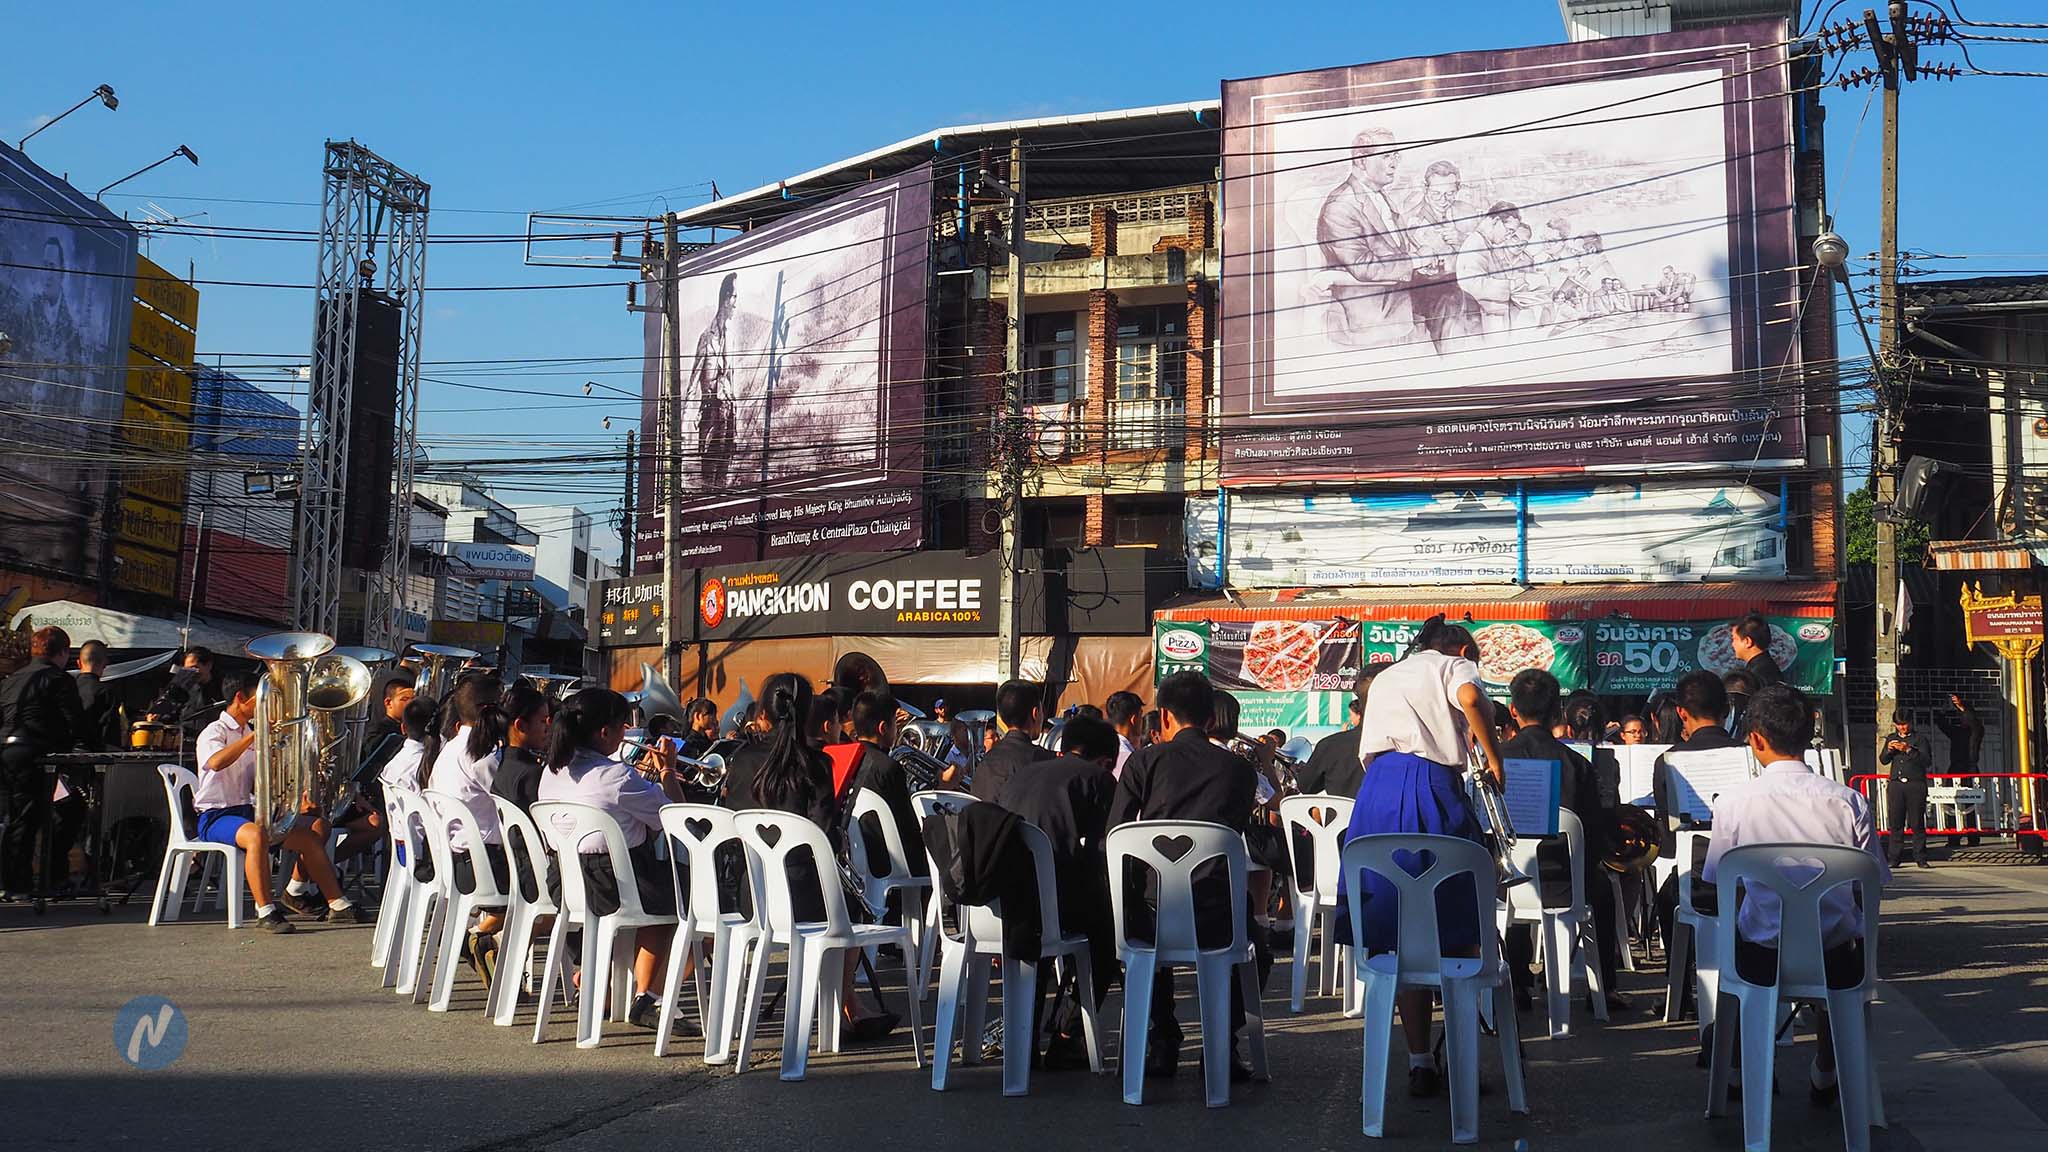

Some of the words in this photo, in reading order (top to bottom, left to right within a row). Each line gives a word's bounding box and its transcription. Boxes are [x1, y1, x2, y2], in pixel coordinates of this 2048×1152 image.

[770, 530, 811, 547] BrandYoung
[812, 528, 819, 541] &
[821, 523, 868, 541] CentralPlaza
[870, 517, 911, 536] Chiangrai
[1477, 566, 1561, 576] 053-77231
[727, 581, 830, 618] PANGKHON
[847, 579, 981, 611] COFFEE
[896, 611, 951, 622] ARABICA
[952, 611, 981, 622] 100%
[1596, 623, 1693, 642] วันอังคาร
[1168, 636, 1197, 649] PIZZA
[1596, 651, 1623, 667] ลด
[1312, 672, 1342, 690] 129
